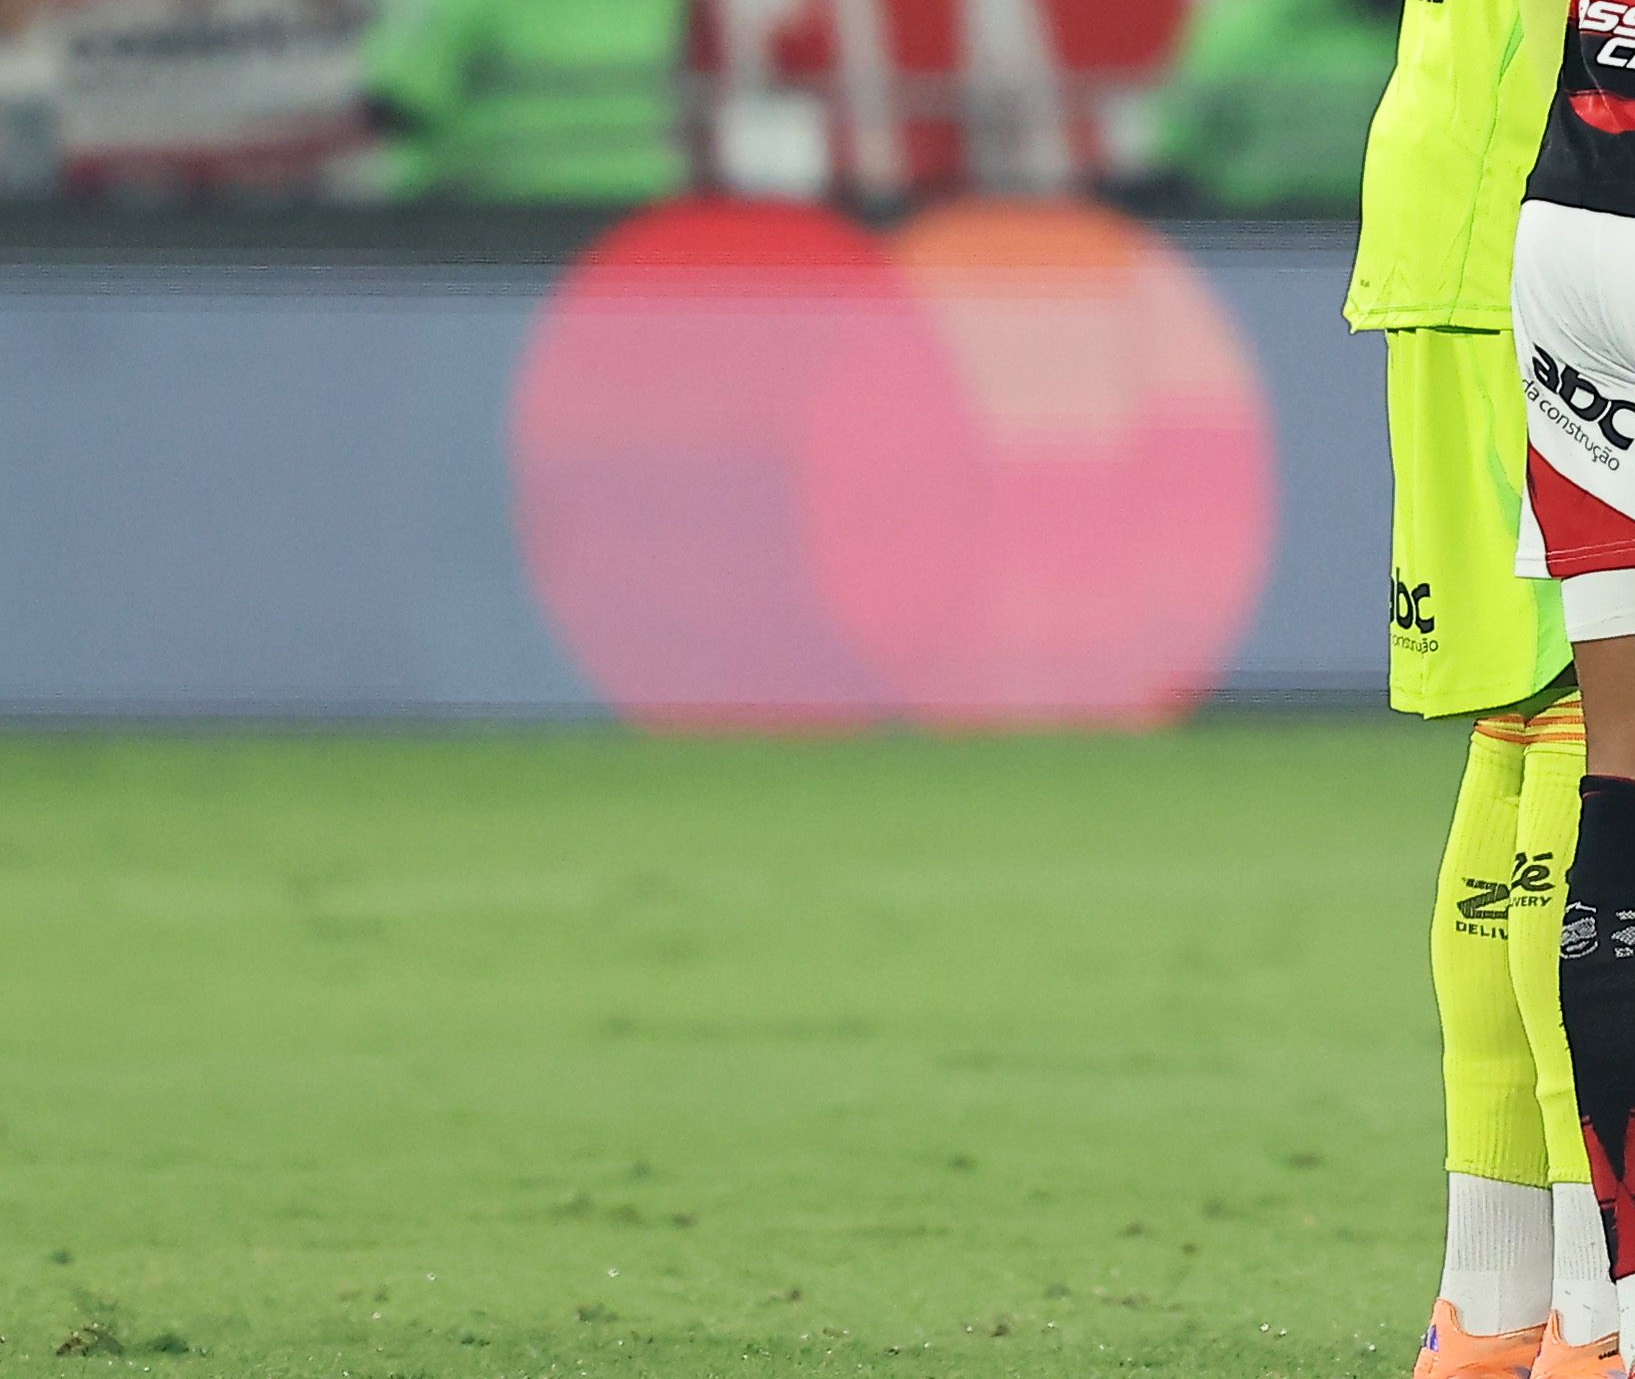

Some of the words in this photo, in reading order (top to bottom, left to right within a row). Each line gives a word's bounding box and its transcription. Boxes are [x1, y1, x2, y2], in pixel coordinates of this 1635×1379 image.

[1539, 399, 1620, 472] construção
[1389, 567, 1435, 634] bc
[1456, 876, 1509, 920] Z
[1456, 921, 1509, 941] DELIV
